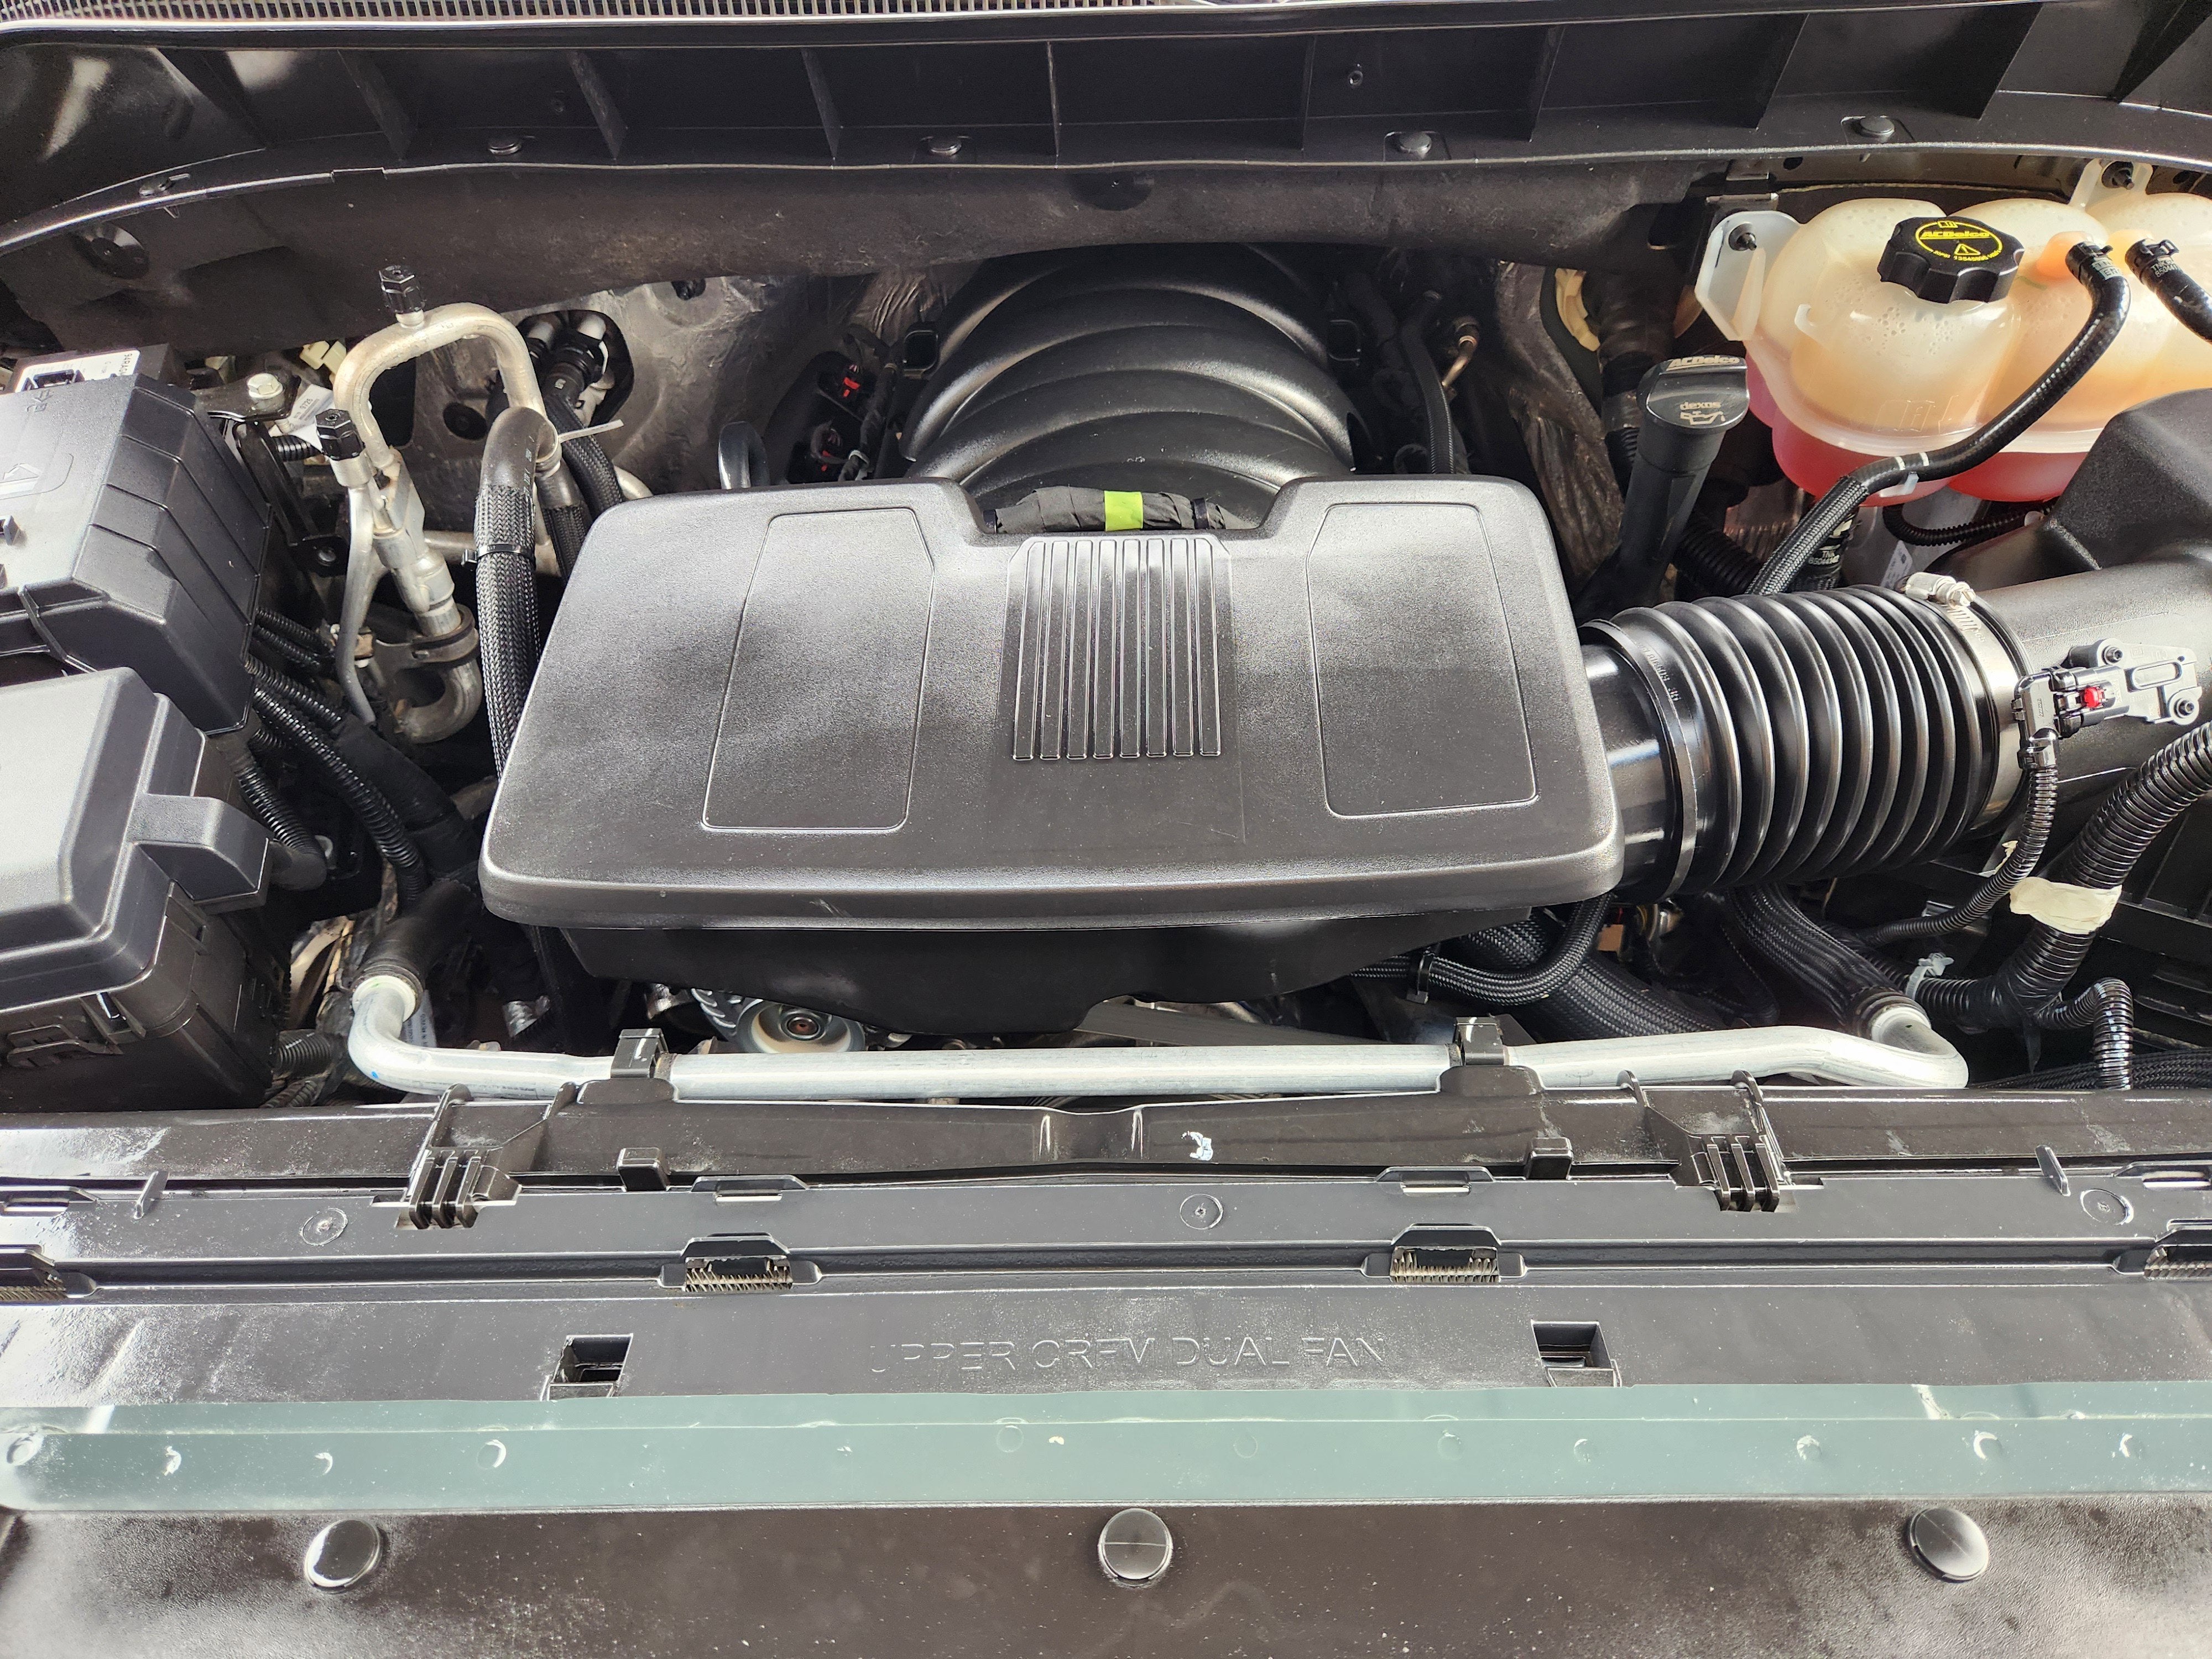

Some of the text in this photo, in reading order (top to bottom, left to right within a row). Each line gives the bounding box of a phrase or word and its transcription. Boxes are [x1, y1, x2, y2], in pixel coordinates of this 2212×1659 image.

[1667, 355, 1740, 368] ACDelco
[1679, 401, 1722, 410] dexos
[870, 1341, 1016, 1373] UPPER
[1172, 1337, 1290, 1366] DUAL
[1301, 1337, 1384, 1367] FAN
